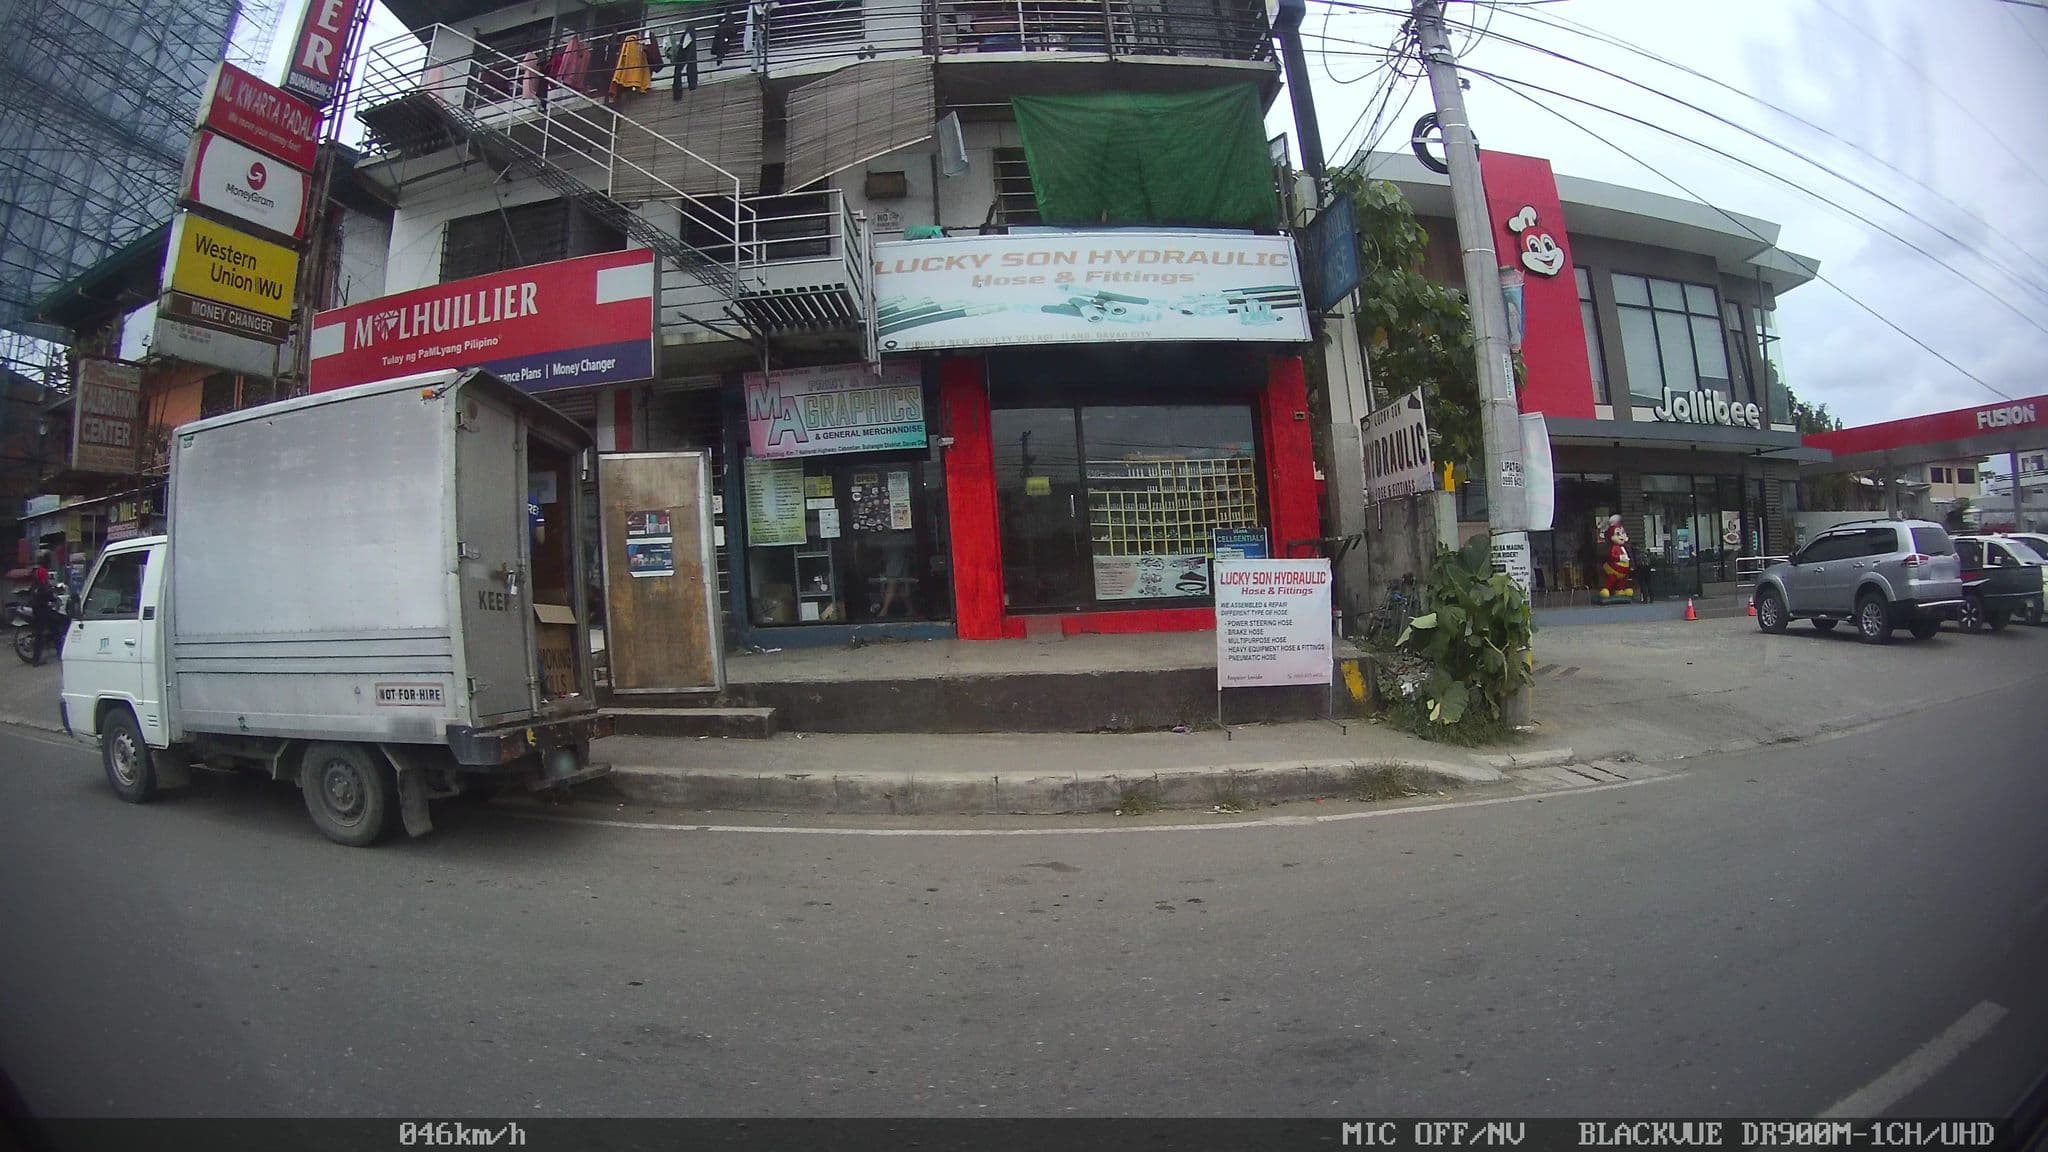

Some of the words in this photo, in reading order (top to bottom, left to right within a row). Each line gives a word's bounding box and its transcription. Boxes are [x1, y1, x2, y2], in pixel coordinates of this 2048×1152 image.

[235, 81, 280, 124] KWARTA
[225, 183, 275, 208] MoneyGram
[195, 233, 257, 270] Western
[874, 253, 993, 276] LUCKY
[1001, 250, 1079, 268] SON
[1087, 249, 1290, 267] HYDRAULIC
[210, 262, 253, 292] Union
[258, 277, 283, 300] WU
[971, 274, 1046, 289] Hose
[1054, 271, 1076, 284] &
[1085, 270, 1195, 285] Fittings
[191, 301, 227, 321] MONEY
[228, 310, 273, 334] CHANGER
[405, 352, 416, 362] ng
[464, 337, 499, 350] Pilipino
[521, 366, 542, 381] Plans
[552, 362, 580, 377] Money
[580, 358, 616, 373] Changer
[804, 387, 922, 429] GRAPHICS
[1656, 386, 1760, 428] Jollibee
[1976, 404, 2036, 430] FUSION
[822, 430, 861, 440] GENERAL
[863, 424, 923, 437] MERCHANDISE
[1363, 422, 1427, 480] HYDRAULIC
[1220, 571, 1250, 585] LUCKY
[1252, 571, 1272, 585] SON
[1274, 571, 1326, 585] HYDRAULIC
[1241, 587, 1266, 595] Hose
[1268, 587, 1275, 595] &
[1277, 586, 1313, 597] Fittings
